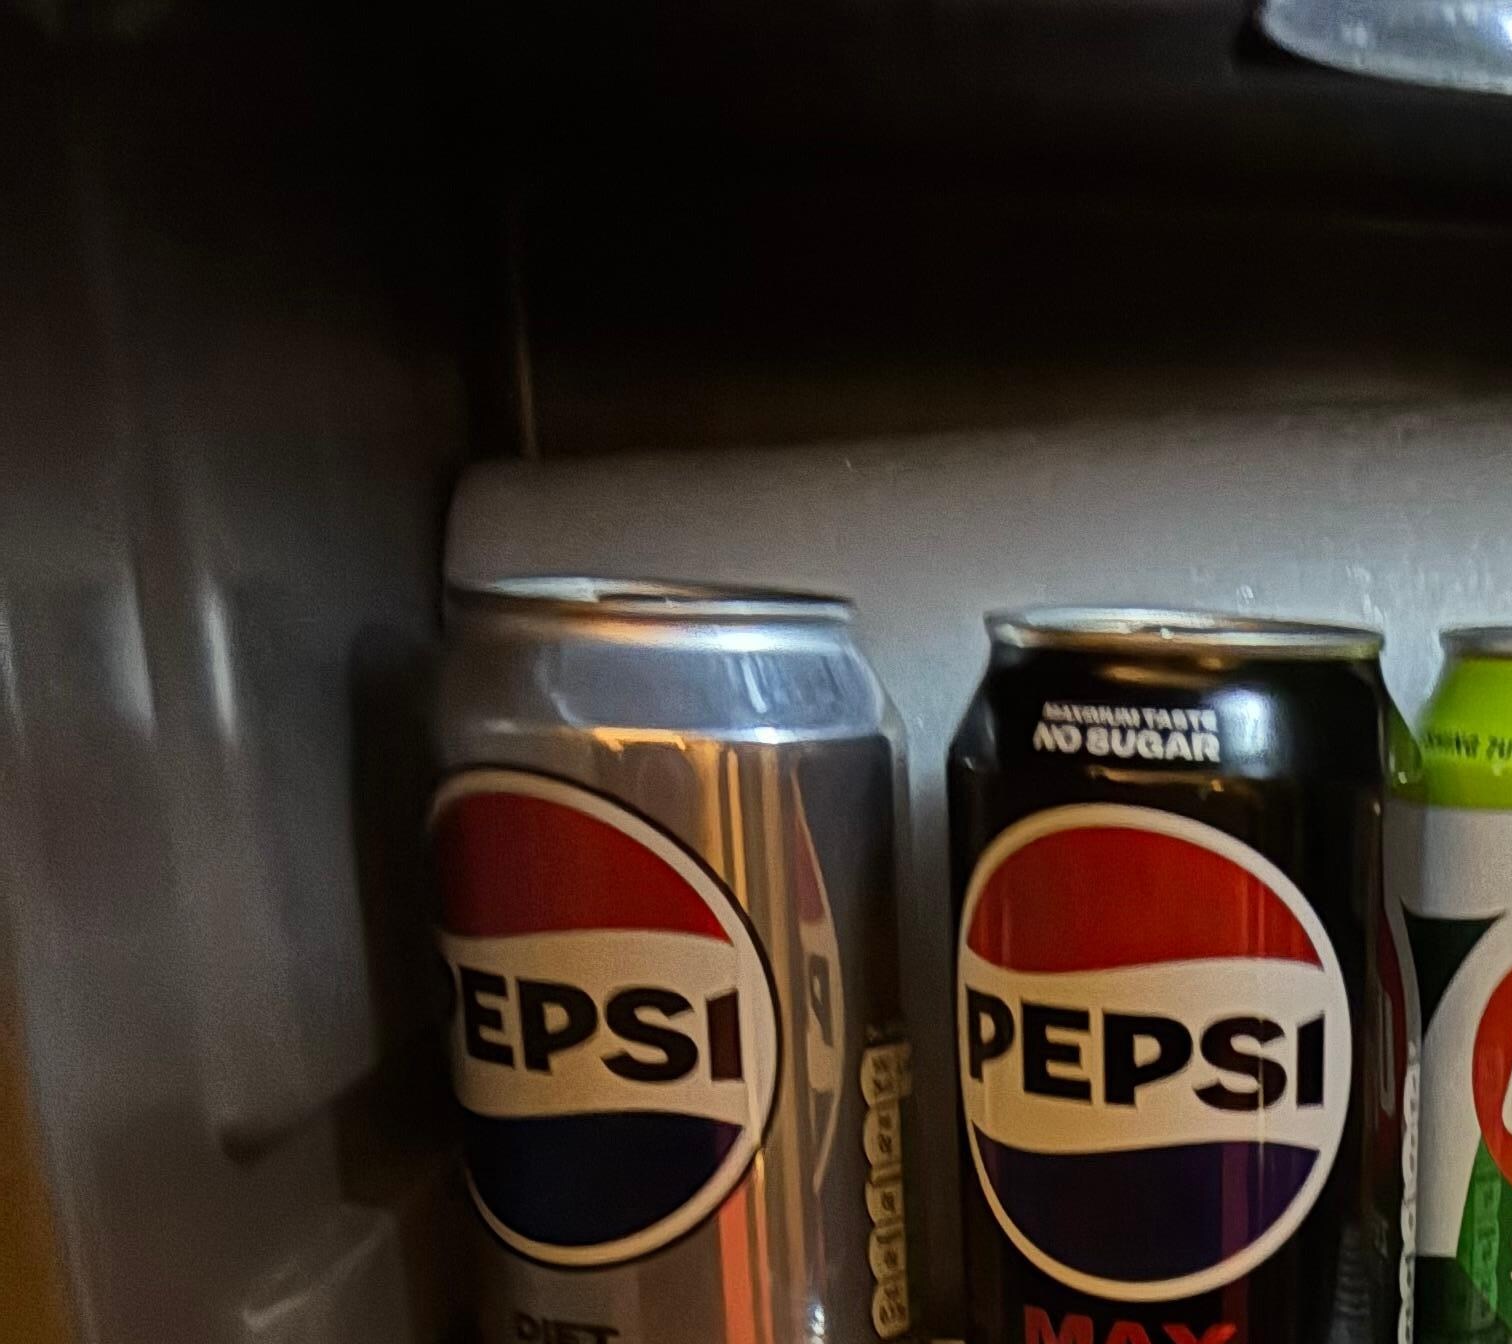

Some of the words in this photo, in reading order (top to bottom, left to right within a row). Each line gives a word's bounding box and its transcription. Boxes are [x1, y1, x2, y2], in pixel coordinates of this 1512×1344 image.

[1033, 720, 1083, 753] NO
[1085, 725, 1221, 762] SUGAR
[460, 964, 744, 1083] EPSI
[965, 984, 1326, 1111] PEPSI
